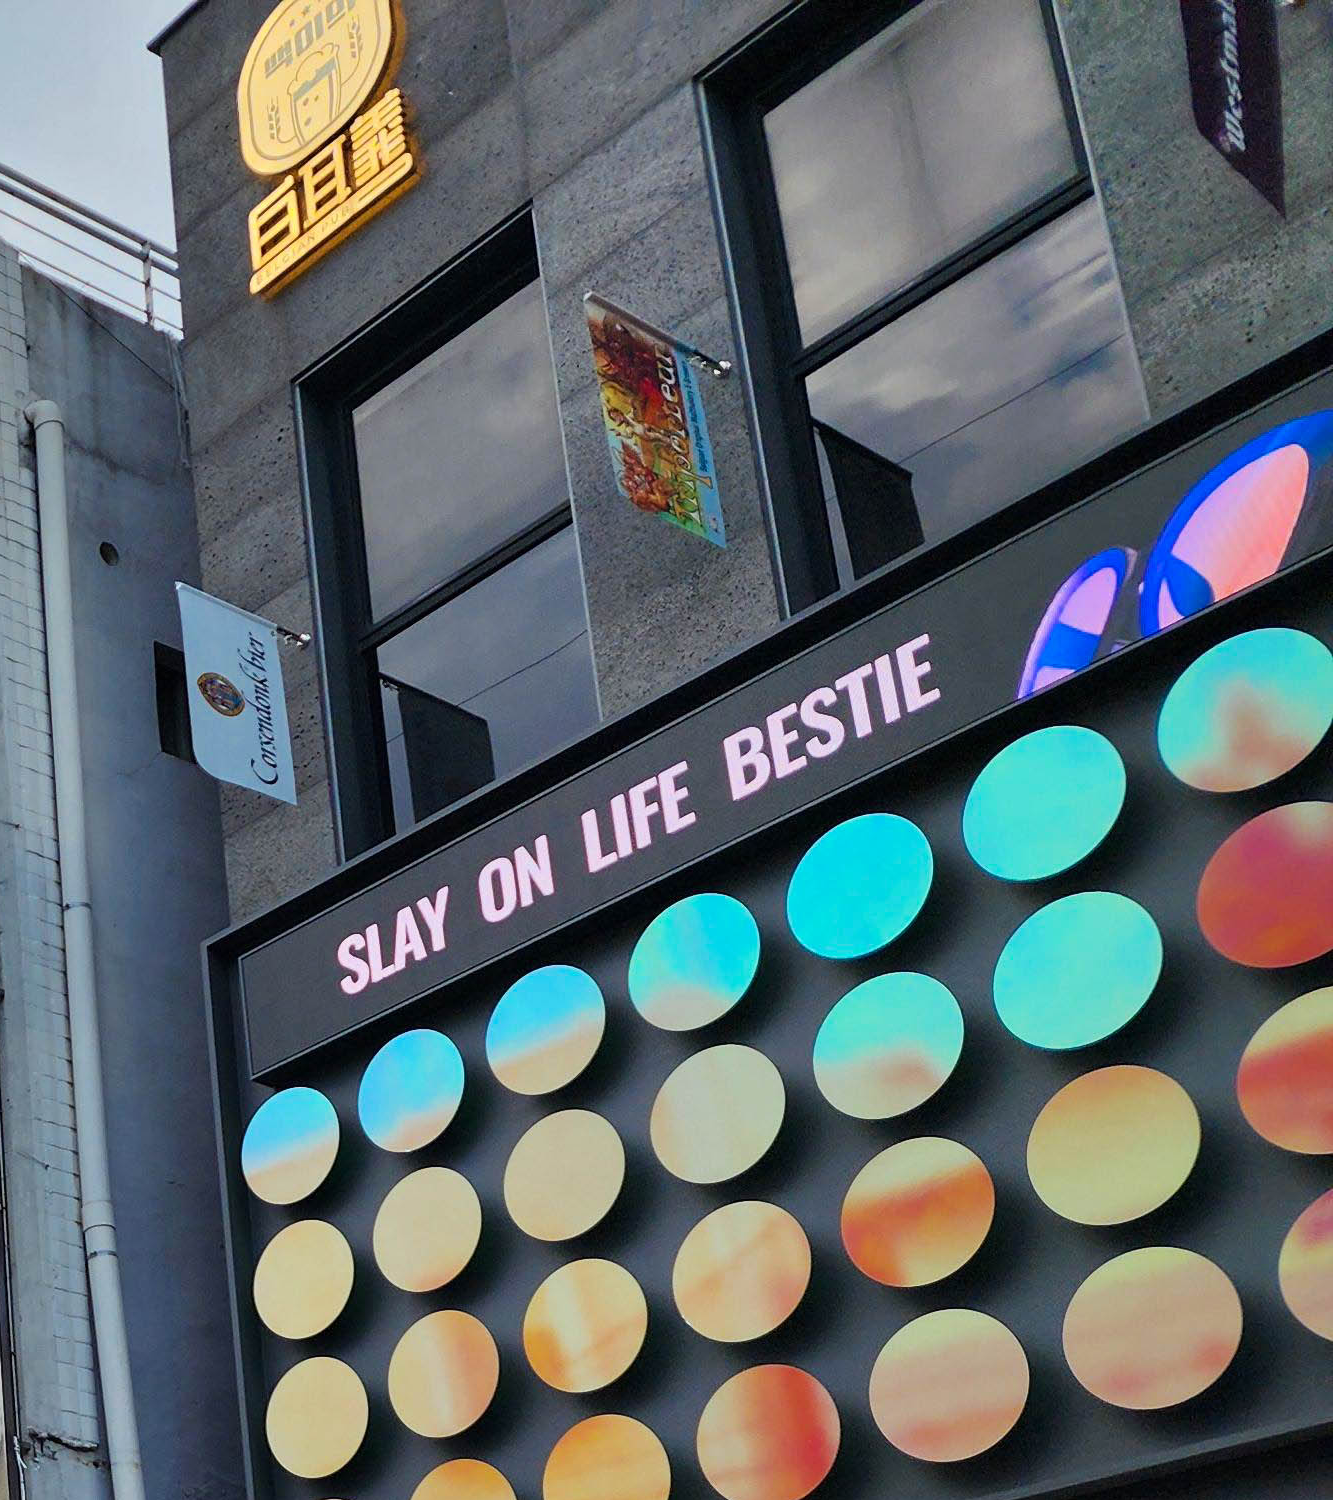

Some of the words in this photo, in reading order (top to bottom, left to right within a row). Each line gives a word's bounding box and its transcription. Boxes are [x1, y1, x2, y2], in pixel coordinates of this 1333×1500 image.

[239, 660, 279, 786] Corsendonk
[337, 884, 450, 996] SLAY
[478, 833, 555, 925] ON
[580, 759, 697, 874] LIFE
[722, 632, 941, 802] BESTIE
